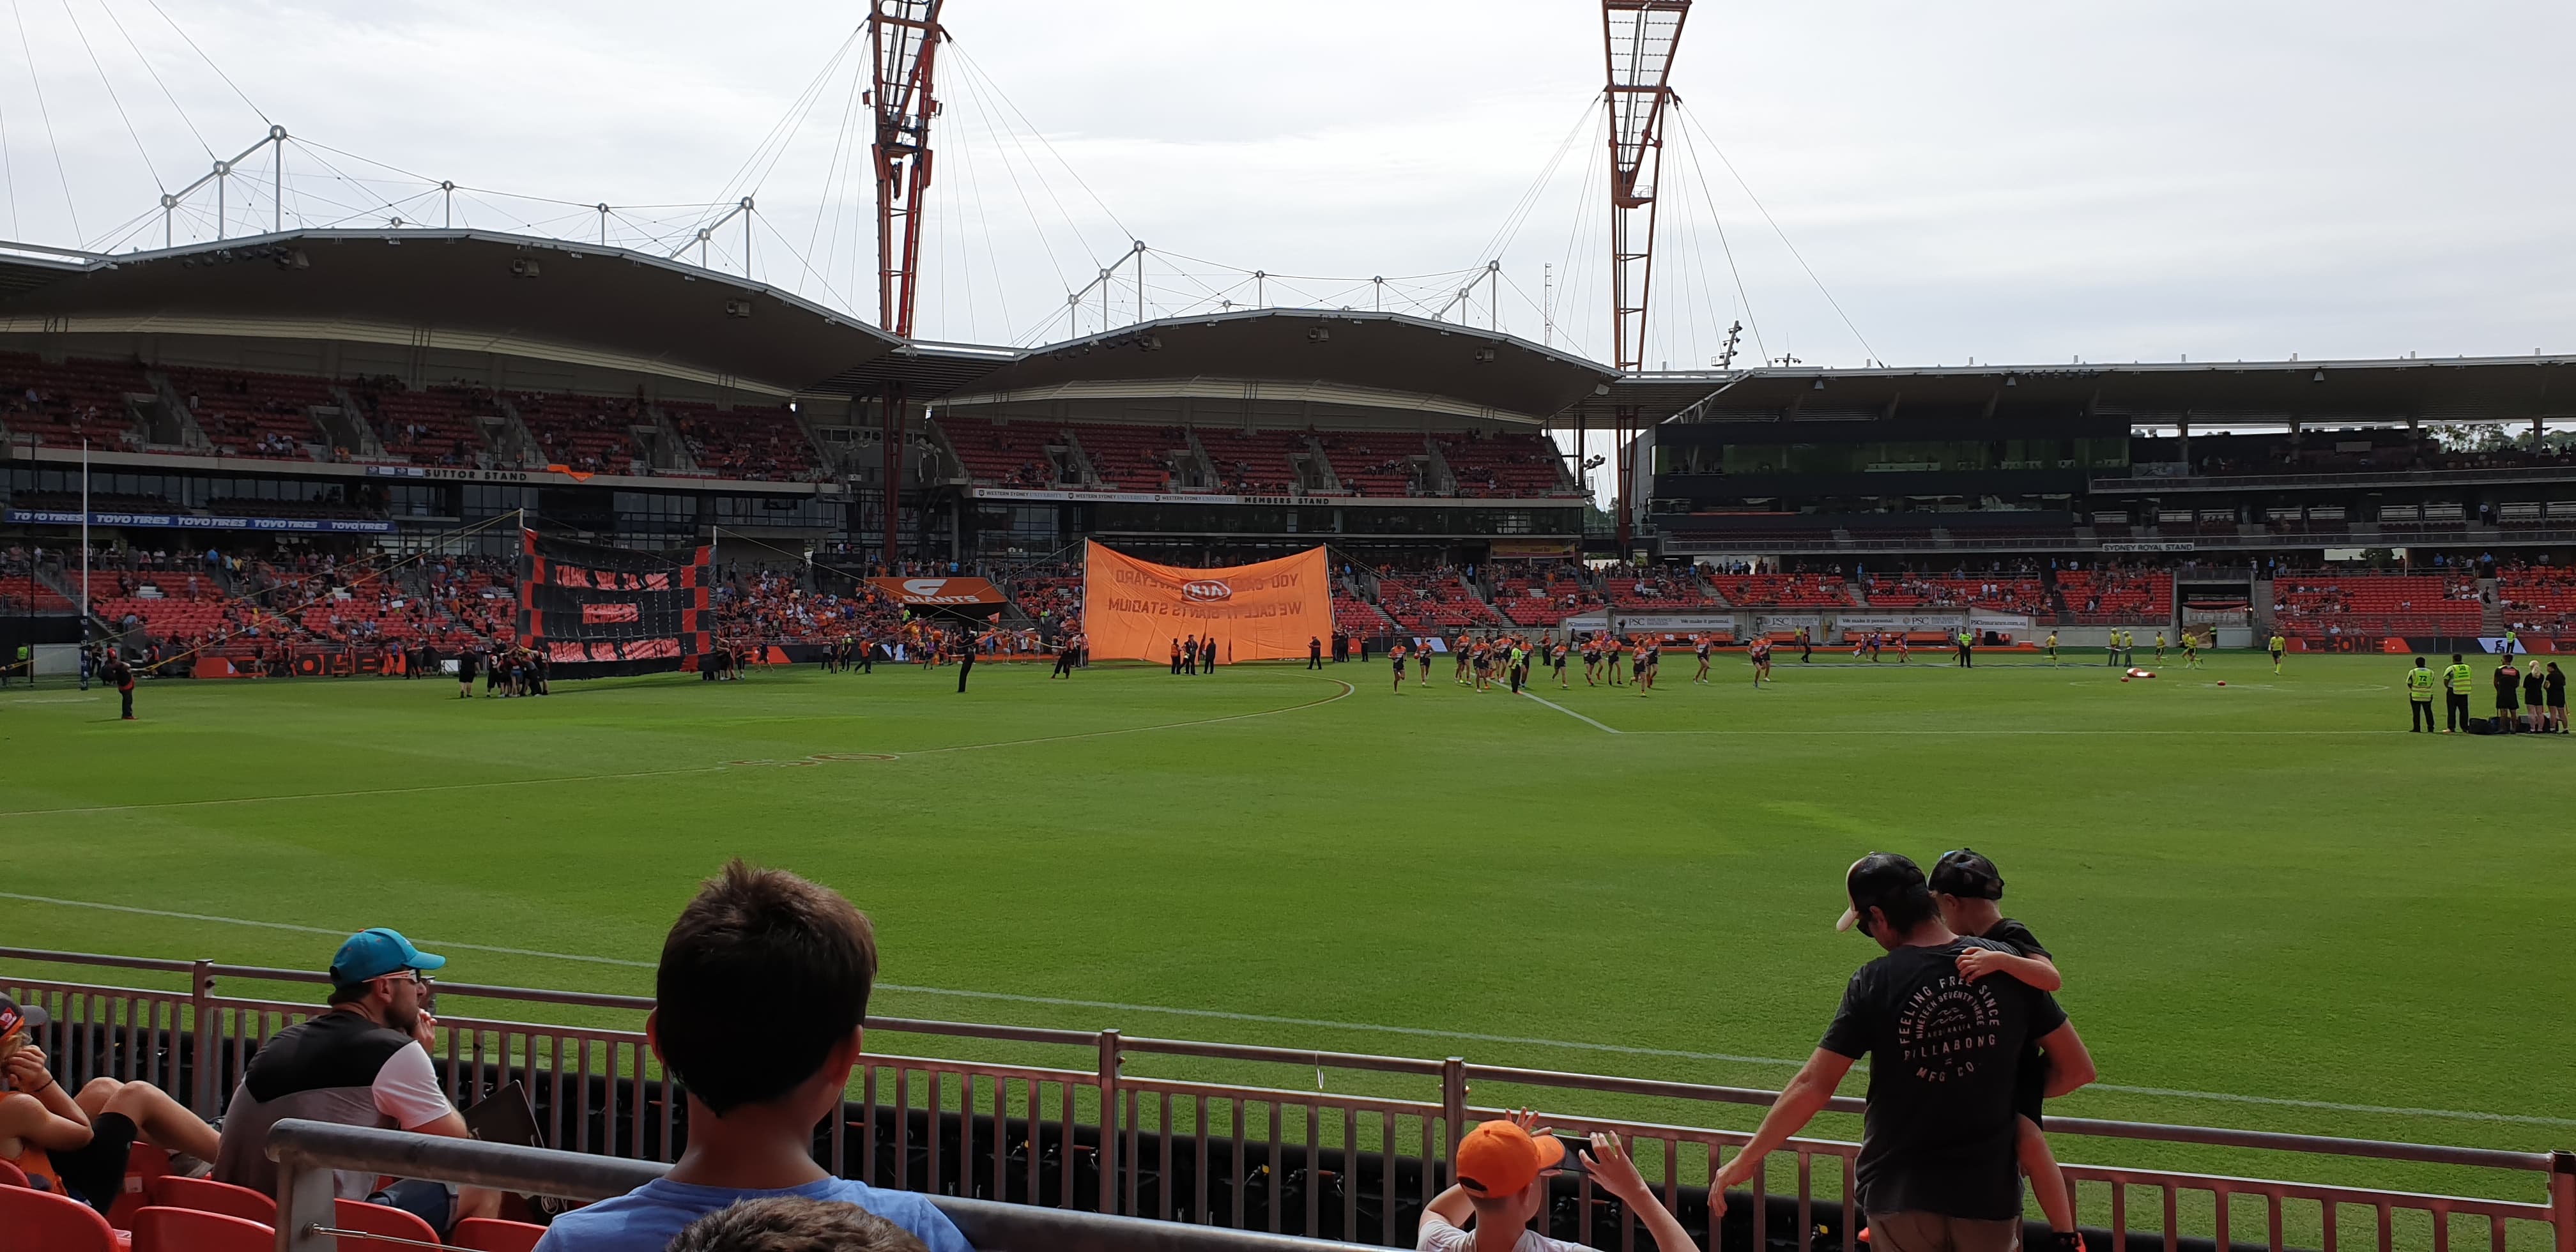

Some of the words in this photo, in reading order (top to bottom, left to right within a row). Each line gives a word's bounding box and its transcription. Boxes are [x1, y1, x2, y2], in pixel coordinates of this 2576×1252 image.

[425, 469, 475, 479] SUTTOR
[484, 471, 527, 481] STAND
[49, 513, 84, 522] TIRES
[96, 514, 133, 523] TOYO
[133, 515, 170, 524] TIRES
[178, 517, 211, 526] TOYO
[211, 518, 247, 527] TIRES
[254, 519, 287, 528] TOYO
[288, 520, 318, 528] TIRES
[1899, 986, 1933, 1044] FEELING
[1979, 985, 2000, 1026] SINCE
[1916, 1000, 1938, 1039] NINETEEN
[1938, 991, 1974, 1003] SEVENTY
[1972, 999, 1985, 1026] THREE
[1928, 1023, 1971, 1038] AUSRALIA
[1917, 1067, 1946, 1081] MFG
